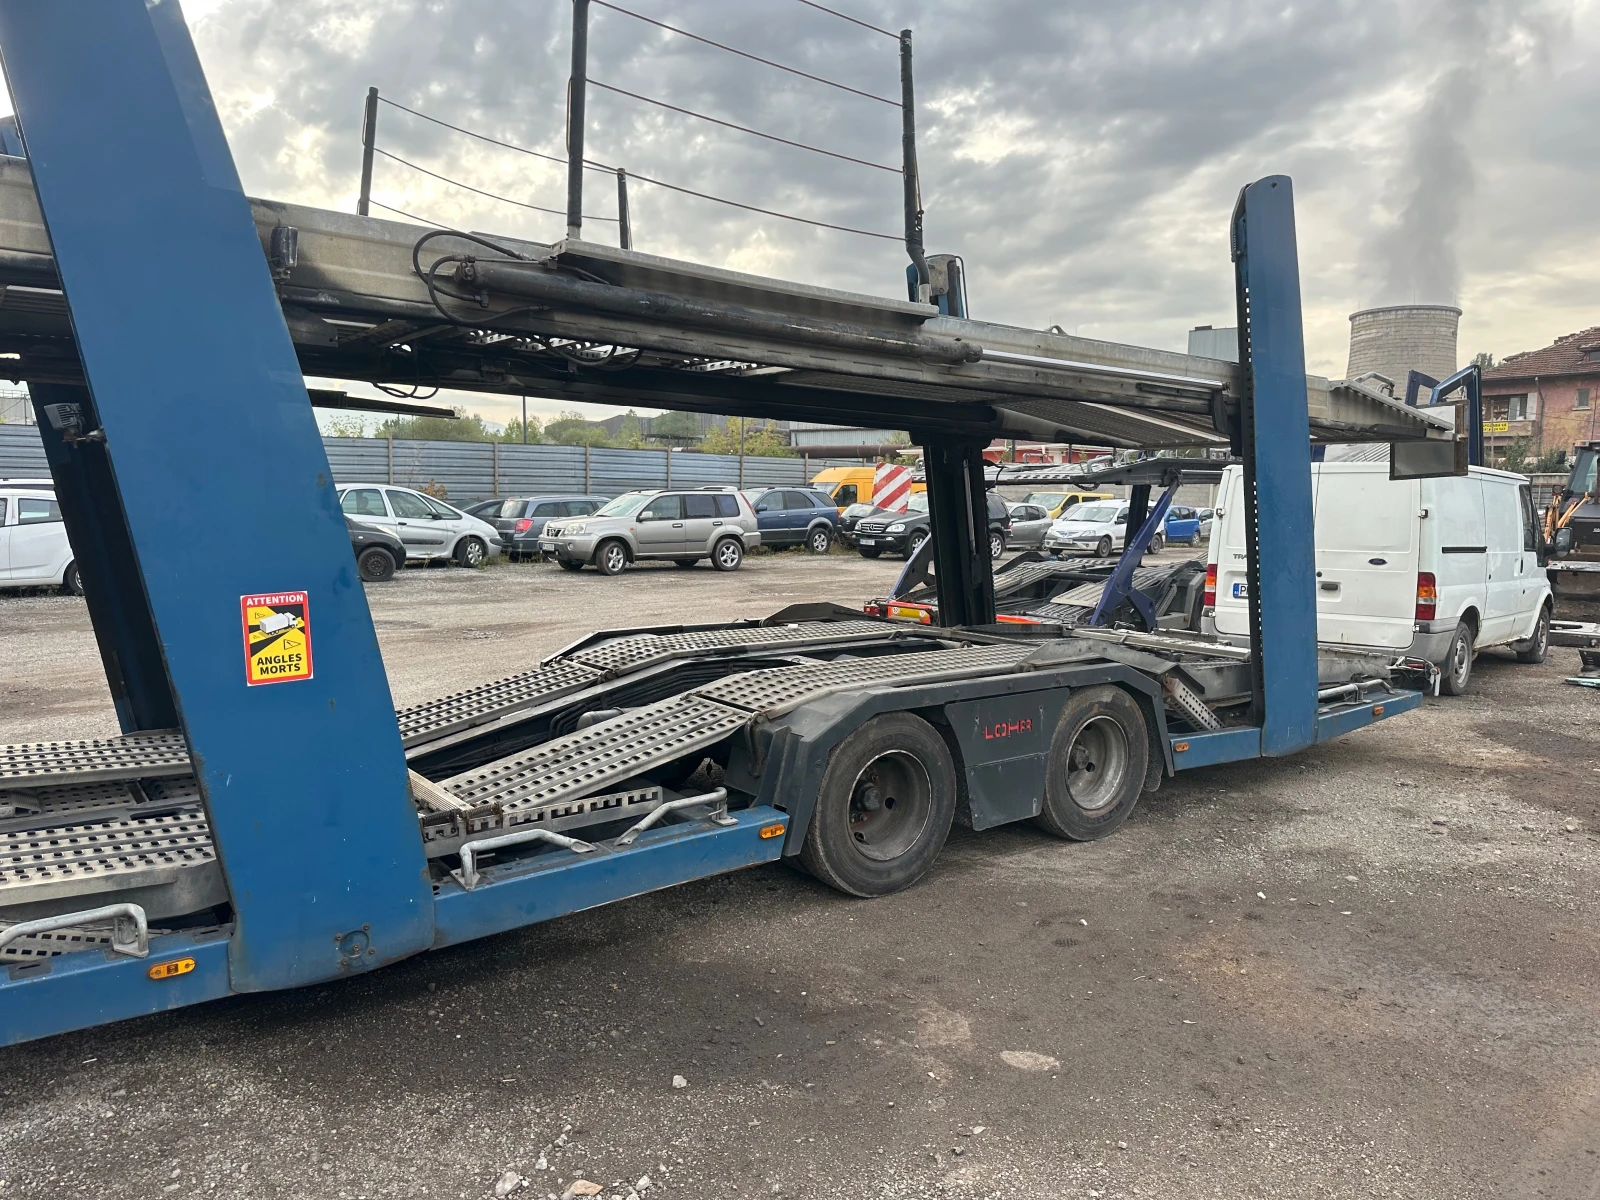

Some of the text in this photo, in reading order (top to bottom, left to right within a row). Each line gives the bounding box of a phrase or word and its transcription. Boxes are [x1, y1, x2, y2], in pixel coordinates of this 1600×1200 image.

[246, 594, 304, 606] ATTENTION
[257, 653, 302, 666] ANGLES
[260, 663, 301, 675] MORTS
[985, 718, 1033, 740] LOHR
